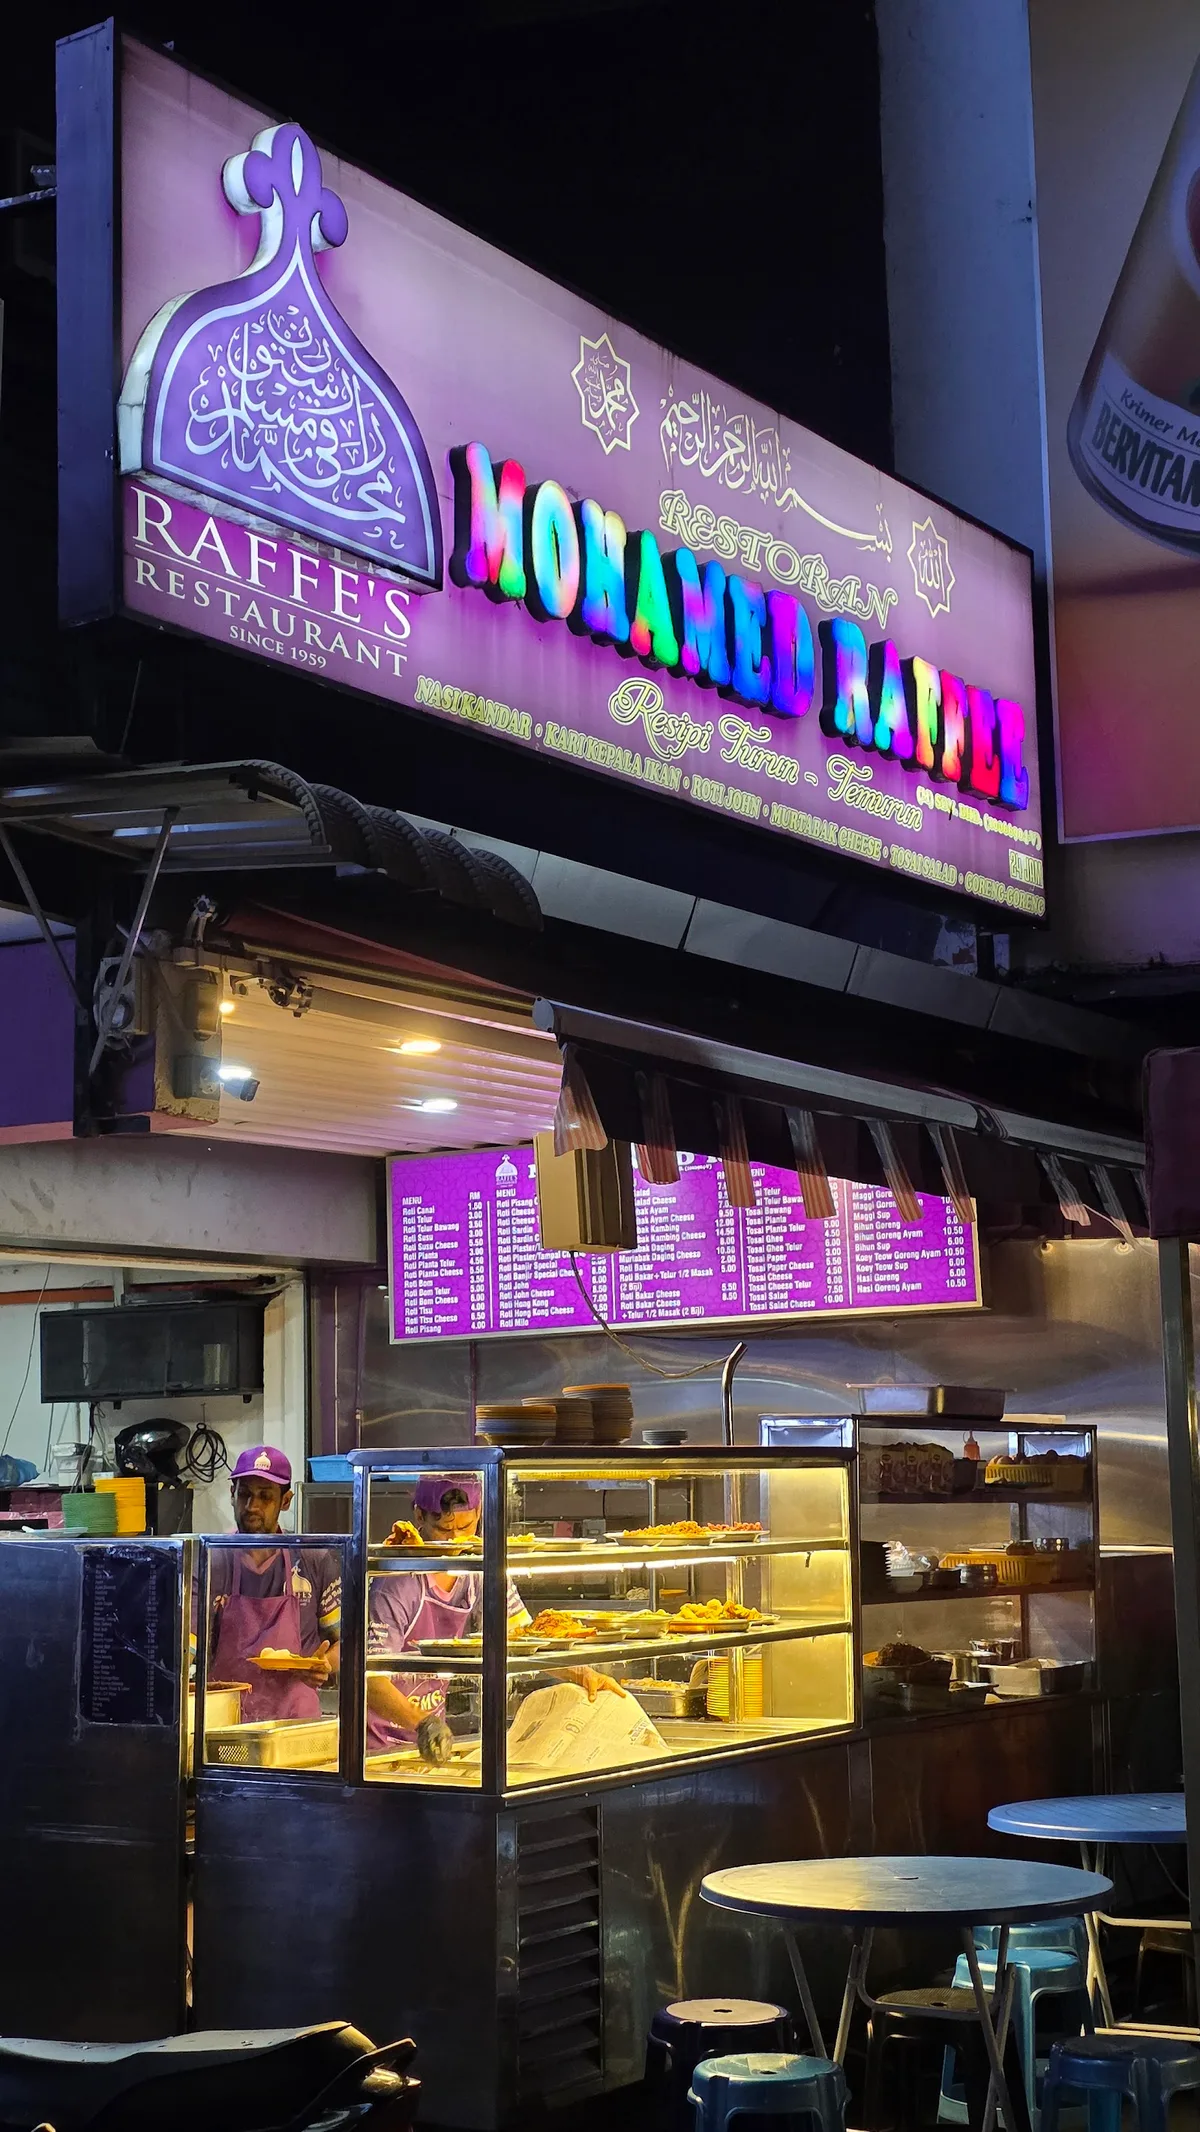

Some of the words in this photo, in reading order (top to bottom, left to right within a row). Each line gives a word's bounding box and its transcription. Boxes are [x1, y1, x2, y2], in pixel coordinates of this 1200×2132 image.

[1120, 388, 1174, 433] Krimer
[131, 486, 411, 639] RAFFE'S
[659, 489, 898, 629] RESTORAN
[452, 441, 814, 718] MOHAMED
[134, 557, 408, 677] RESTAURANT
[230, 625, 285, 655] SINCE
[291, 647, 327, 668] 1959
[608, 677, 714, 761] Resipi
[718, 714, 799, 785] Turun
[826, 754, 924, 831] Temurun
[414, 675, 462, 715] NASI
[460, 691, 532, 740] KANDAR
[543, 721, 586, 759] KARI
[585, 736, 644, 779] KEPALA
[643, 757, 682, 792] IKAN
[691, 774, 726, 806] ROTI
[724, 786, 762, 819] JOHN
[770, 802, 839, 845] MURTABAK
[838, 826, 884, 861] CHEESE
[889, 843, 924, 875] TOSAI
[921, 857, 957, 887] SALAD
[964, 871, 1046, 916] GORENG-GORENG
[1010, 851, 1023, 880] 24
[1023, 856, 1042, 886] JAM
[495, 1188, 516, 1197] MENU
[851, 1190, 874, 1201] Maggi
[874, 1189, 892, 1199] Gore
[402, 1196, 422, 1205] MENU
[852, 1201, 875, 1211] Maggi
[875, 1200, 896, 1209] Goren
[402, 1207, 416, 1215] Roti
[763, 1206, 792, 1215] Bawang
[852, 1211, 875, 1221] Maggi
[876, 1210, 891, 1220] Sup
[402, 1216, 416, 1224] Roti
[416, 1215, 433, 1223] Telur
[402, 1225, 416, 1234] Roti
[416, 1224, 433, 1233] Telur
[433, 1223, 460, 1231] Bawang
[787, 1223, 806, 1232] Telur
[853, 1222, 874, 1231] Bihun
[874, 1220, 901, 1230] Goreng
[402, 1233, 416, 1243] Roti
[417, 1233, 433, 1242] Susu
[765, 1234, 784, 1243] Ghee
[853, 1232, 874, 1241] Bihun
[875, 1231, 901, 1240] Goreng
[902, 1229, 923, 1239] Ayam
[402, 1243, 416, 1252] Roti
[417, 1242, 434, 1251] Susu
[434, 1240, 458, 1250] Cheese
[765, 1243, 784, 1253] Ghee
[784, 1242, 803, 1251] Telur
[854, 1243, 875, 1252] Bihun
[876, 1241, 891, 1251] Sup
[403, 1252, 417, 1261] Roti
[651, 1252, 675, 1261] Daging
[675, 1250, 701, 1259] Cheese
[766, 1253, 787, 1262] Paper
[893, 1250, 920, 1260] Goreng
[920, 1249, 941, 1259] Ayam
[618, 1263, 633, 1273] Roti
[633, 1262, 654, 1272] Bakar
[766, 1262, 788, 1272] Paper
[788, 1261, 814, 1270] Cheese
[894, 1260, 909, 1270] Sup
[403, 1270, 417, 1279] Roti
[439, 1268, 463, 1276] Cheese
[619, 1273, 633, 1282] Roti
[690, 1267, 713, 1277] Masak
[766, 1272, 793, 1281] Cheese
[856, 1273, 873, 1283] Nasi
[873, 1273, 900, 1282] Goreng
[403, 1279, 418, 1288] Roti
[767, 1282, 793, 1291] Cheese
[793, 1279, 812, 1289] Telur
[856, 1283, 873, 1293] Nasi
[873, 1283, 900, 1292] Goreng
[901, 1281, 922, 1292] Ayam
[498, 1291, 513, 1300] Roti
[513, 1290, 529, 1299] John
[530, 1288, 555, 1298] Cheese
[619, 1291, 634, 1300] Roti
[634, 1290, 654, 1300] Bakar
[655, 1289, 680, 1298] Cheese
[767, 1290, 788, 1300] Salad
[499, 1300, 513, 1309] Roti
[513, 1299, 531, 1308] Hong
[531, 1298, 549, 1307] Kong
[620, 1301, 634, 1310] Roti
[634, 1300, 655, 1309] Bakar
[655, 1299, 681, 1308] Cheese
[768, 1300, 788, 1310] Salad
[789, 1299, 815, 1308] Cheese
[404, 1307, 418, 1316] Roti
[657, 1307, 681, 1317] Masak
[499, 1318, 513, 1327] Roti
[514, 1317, 529, 1326] Milo
[404, 1325, 418, 1334] Roti
[419, 1324, 441, 1333] Pisang
